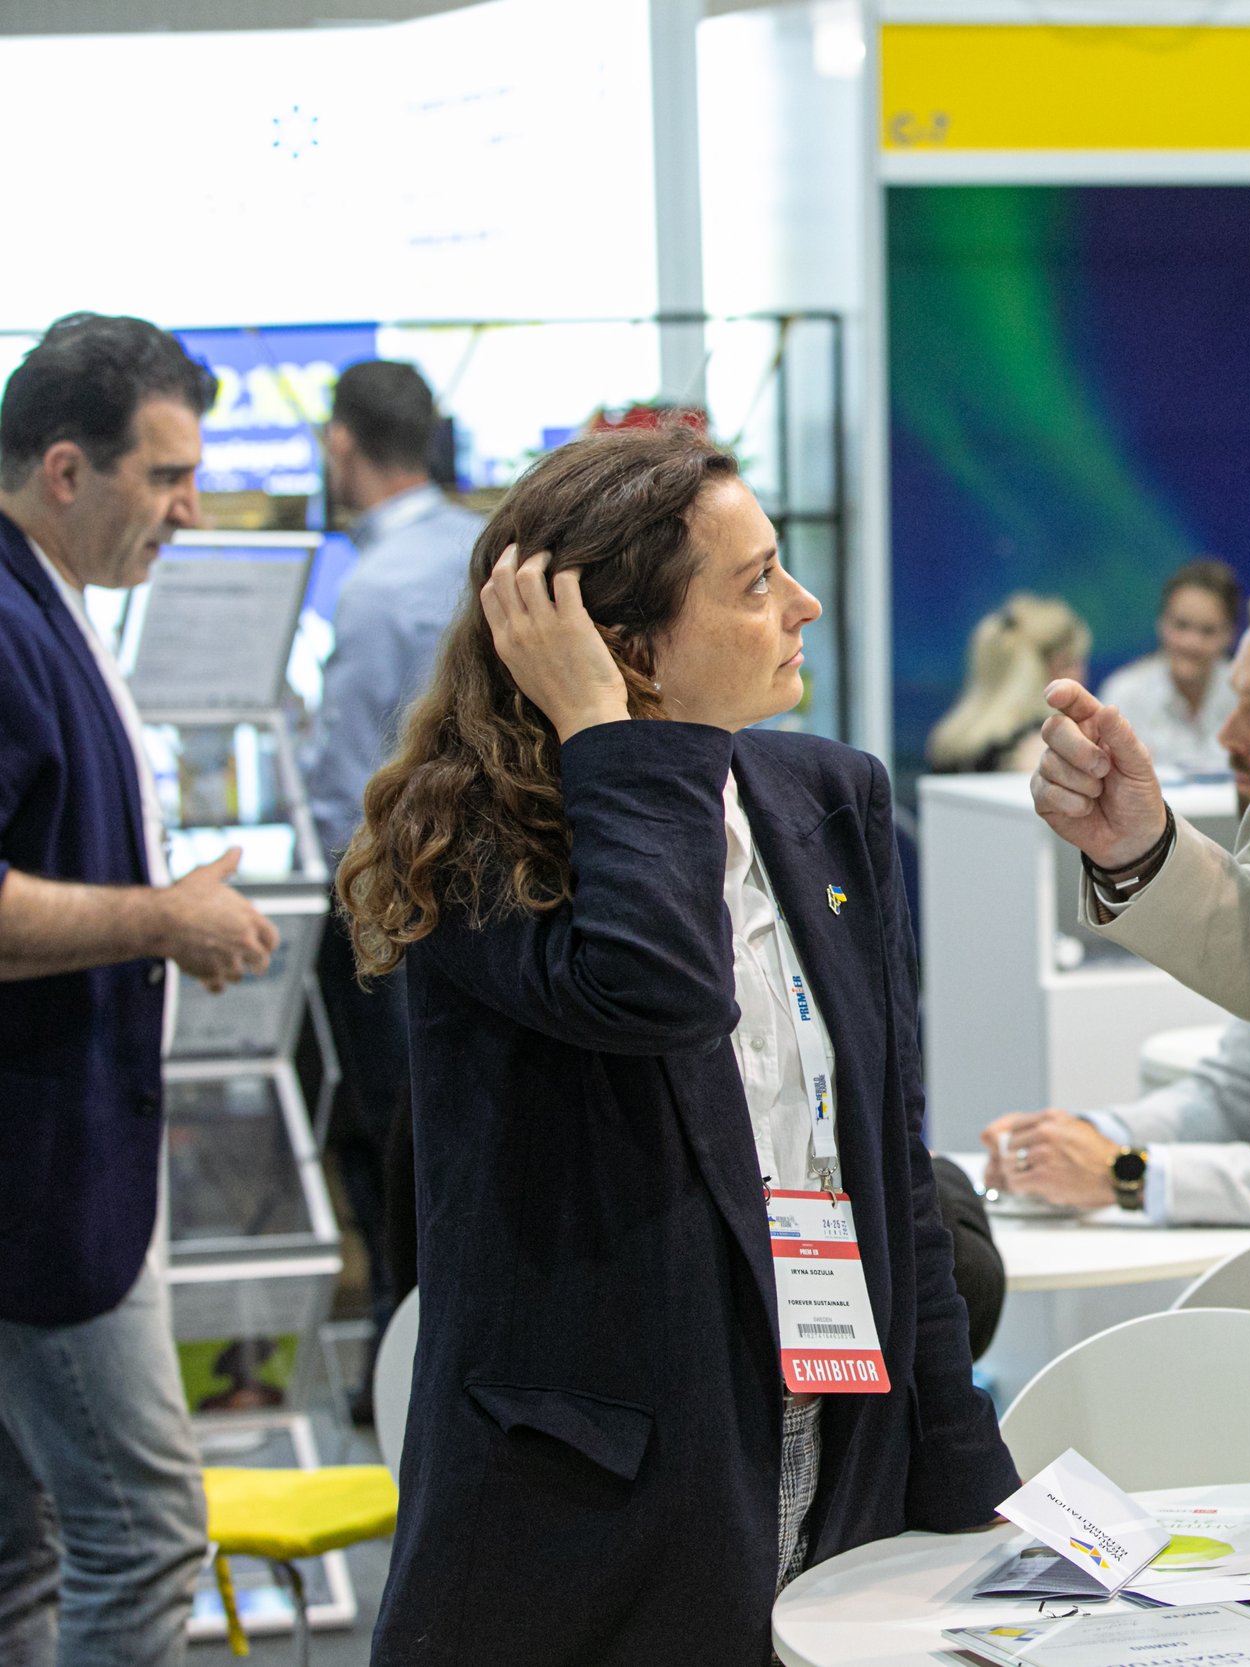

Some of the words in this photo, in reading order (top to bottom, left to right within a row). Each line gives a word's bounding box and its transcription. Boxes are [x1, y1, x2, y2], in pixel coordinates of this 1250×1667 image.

[822, 1218, 841, 1229] 24-25
[792, 1359, 880, 1382] EXHIBITOR
[1047, 1493, 1128, 1555] REHABILITATION
[1083, 1524, 1123, 1557] TRAUMA
[1099, 1542, 1120, 1561] WAR
